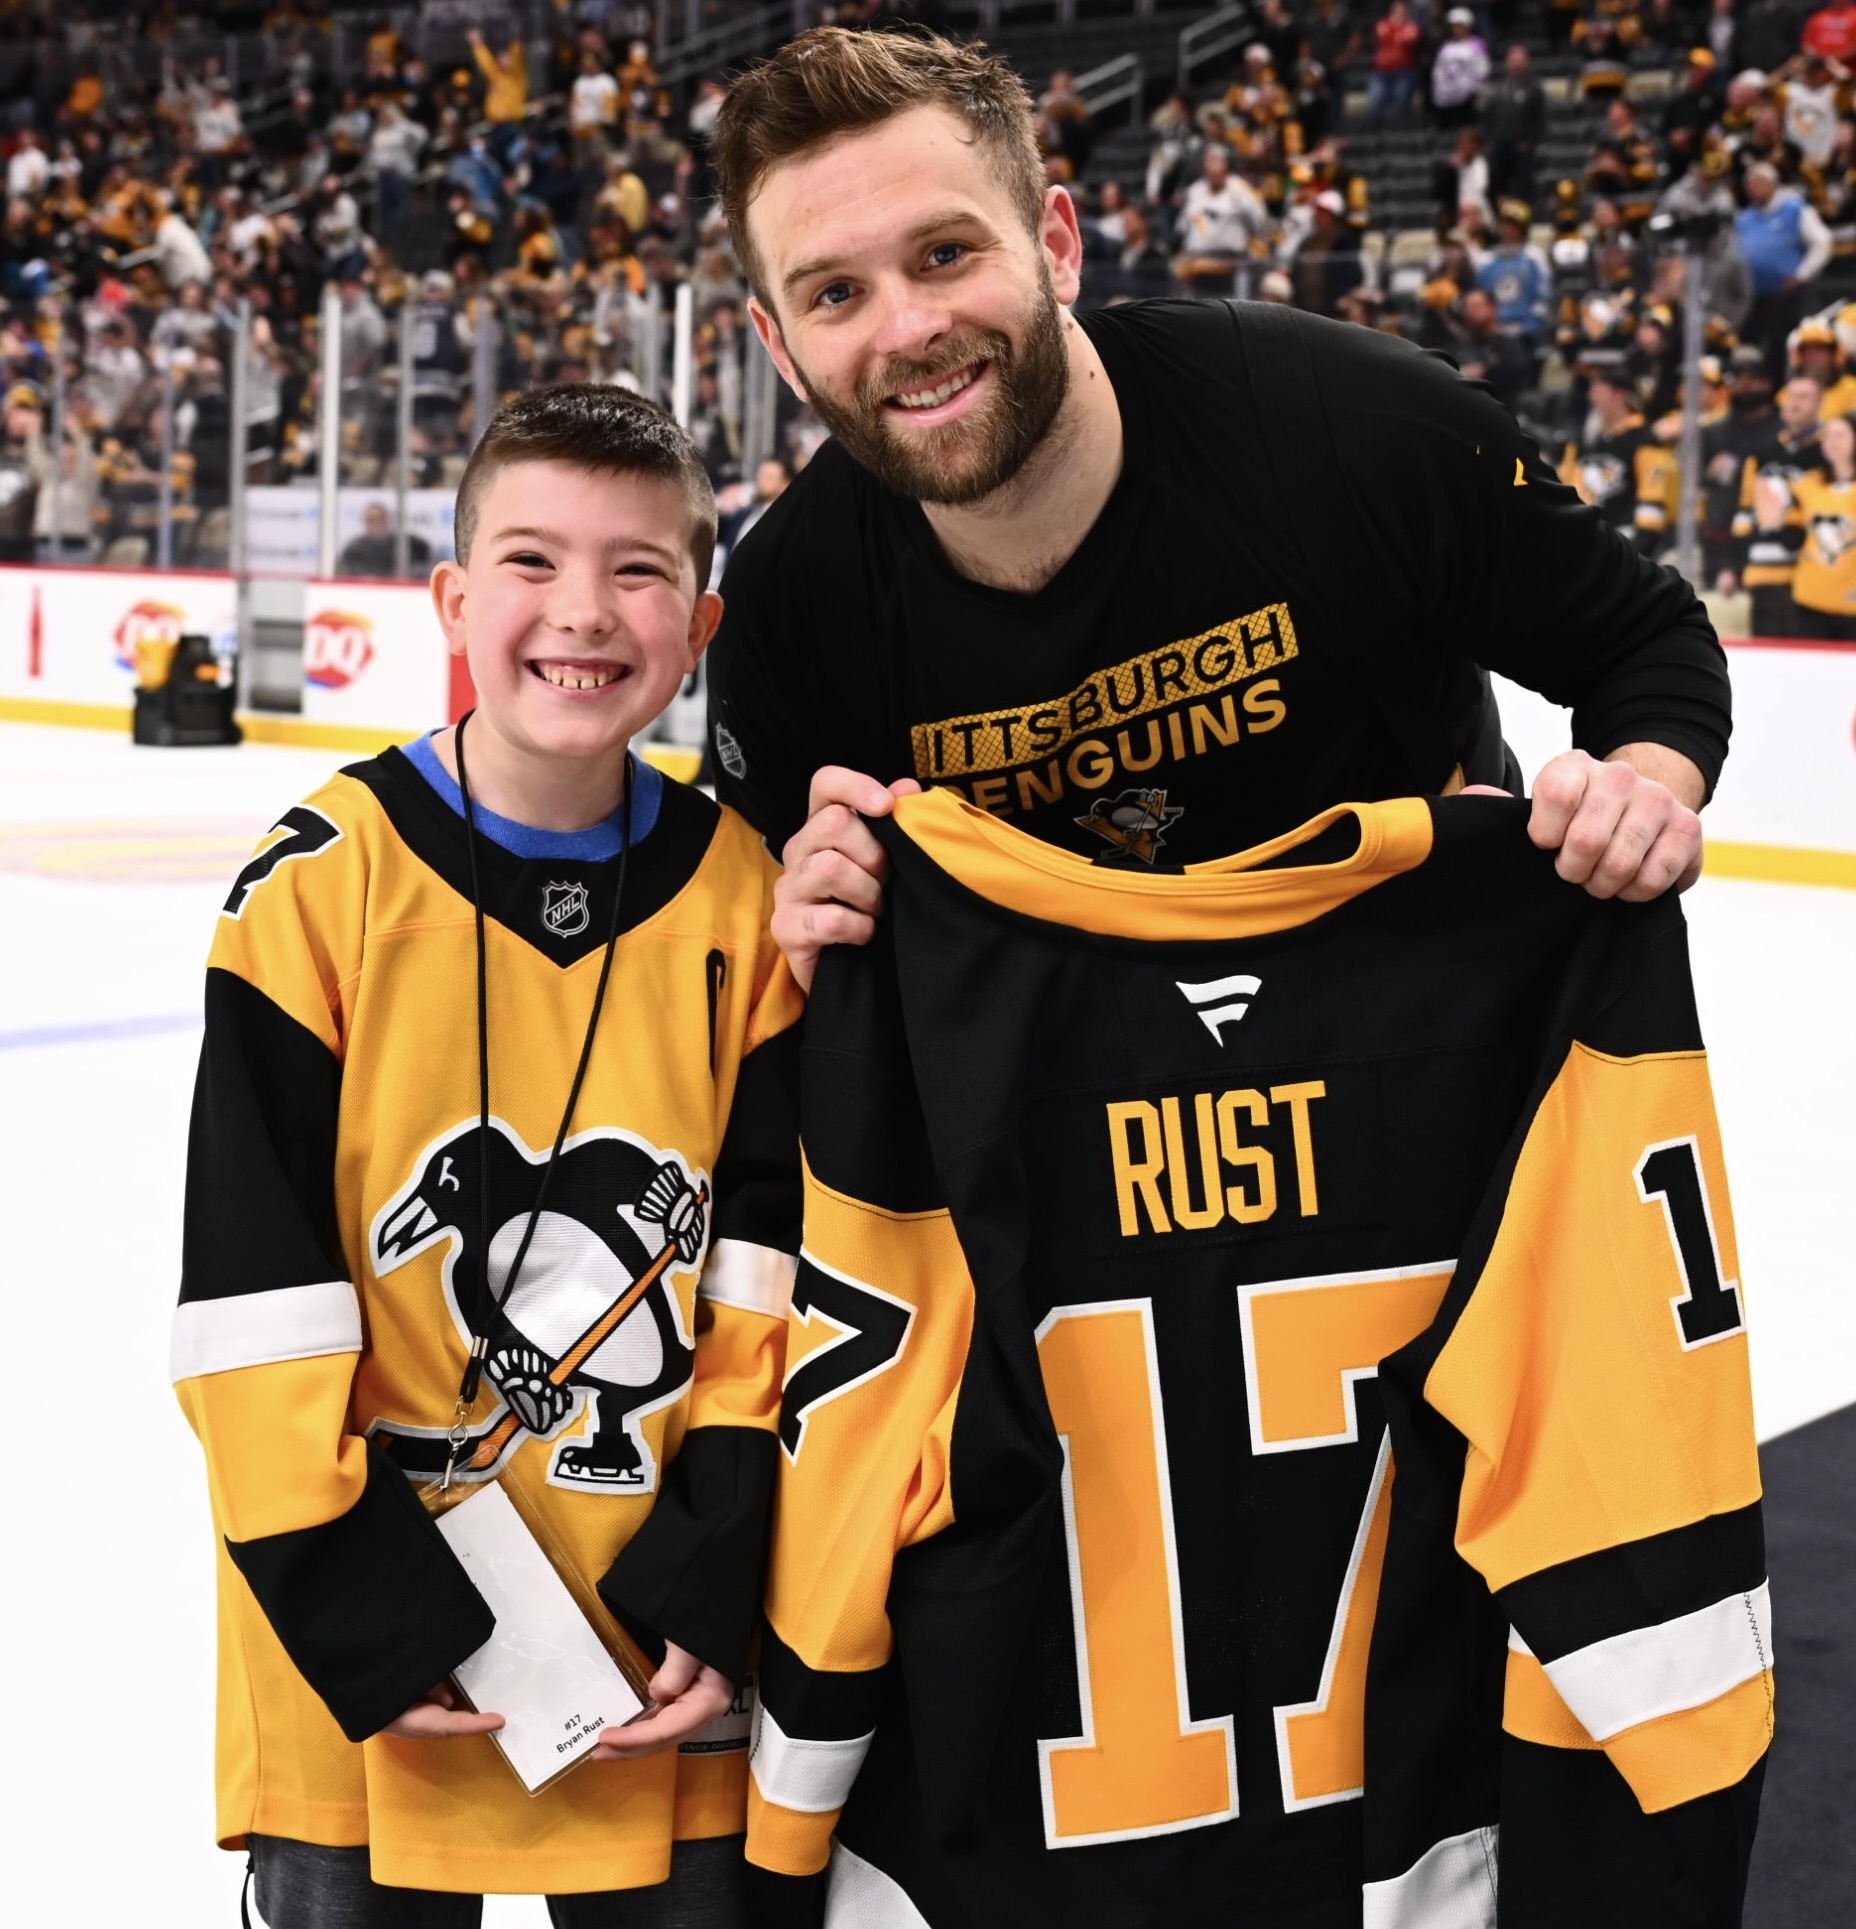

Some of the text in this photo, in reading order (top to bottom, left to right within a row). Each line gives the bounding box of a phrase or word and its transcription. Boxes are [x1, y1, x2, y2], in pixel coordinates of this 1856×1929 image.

[551, 896, 580, 924] NHL
[1106, 1080, 1326, 1236] RUST
[1633, 1135, 1747, 1353] 1
[779, 1247, 918, 1467] 7
[1034, 1259, 1457, 1849] 17
[556, 1716, 605, 1753] Bryan Rust
[564, 1714, 581, 1731] #17
